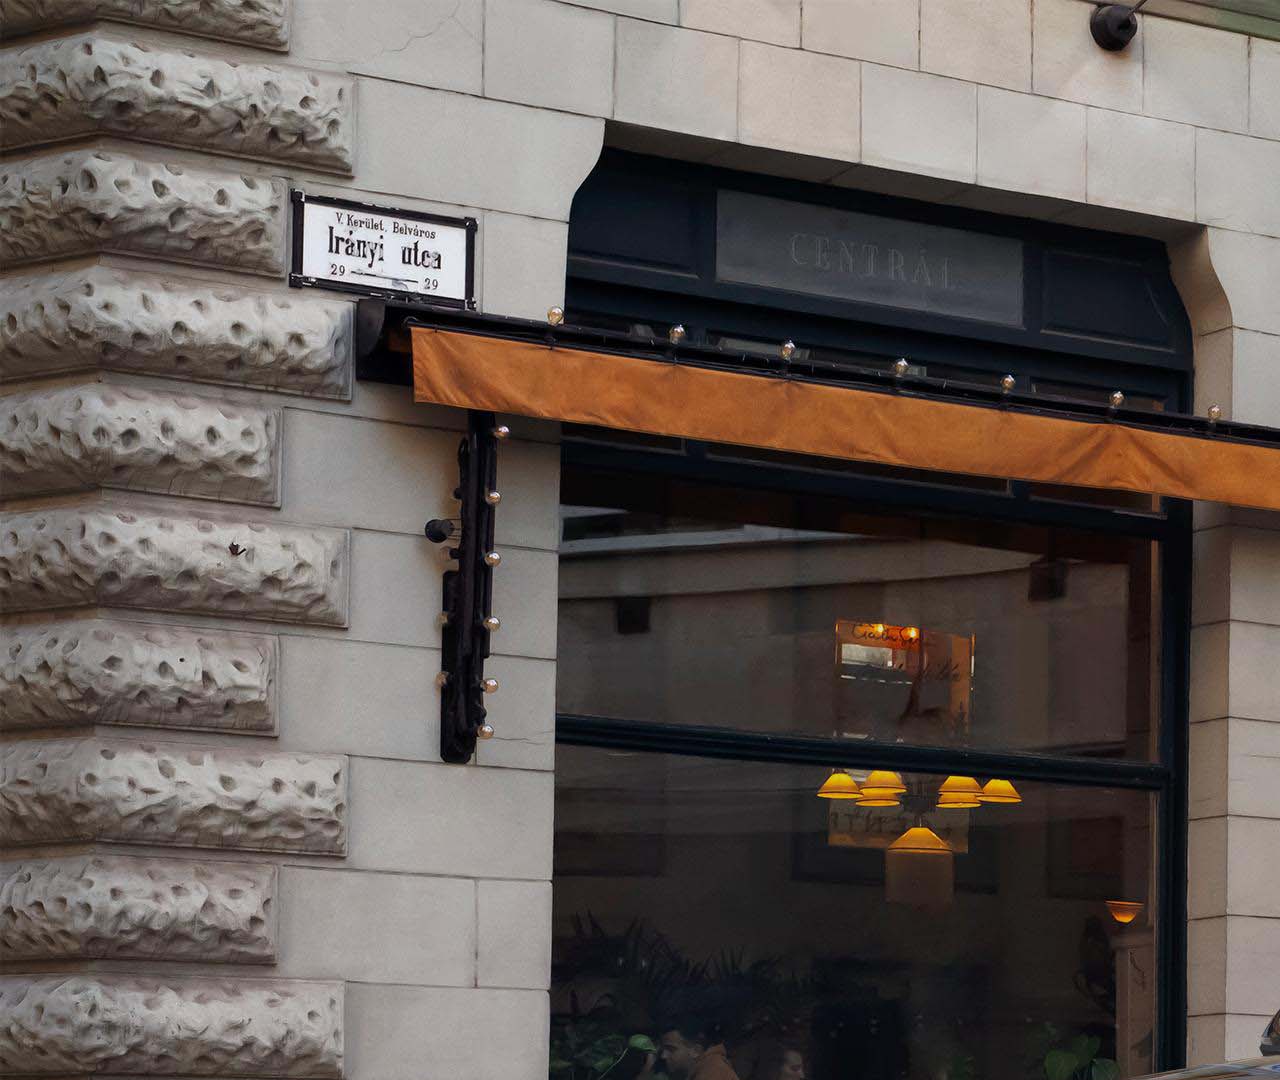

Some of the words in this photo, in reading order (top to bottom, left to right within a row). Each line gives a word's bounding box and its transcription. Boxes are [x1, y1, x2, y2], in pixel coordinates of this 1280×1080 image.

[335, 211, 344, 225] V.
[392, 220, 437, 240] Belváros
[327, 225, 385, 269] Irányi
[400, 239, 442, 270] utca
[330, 263, 346, 277] 29
[423, 277, 439, 291] 29
